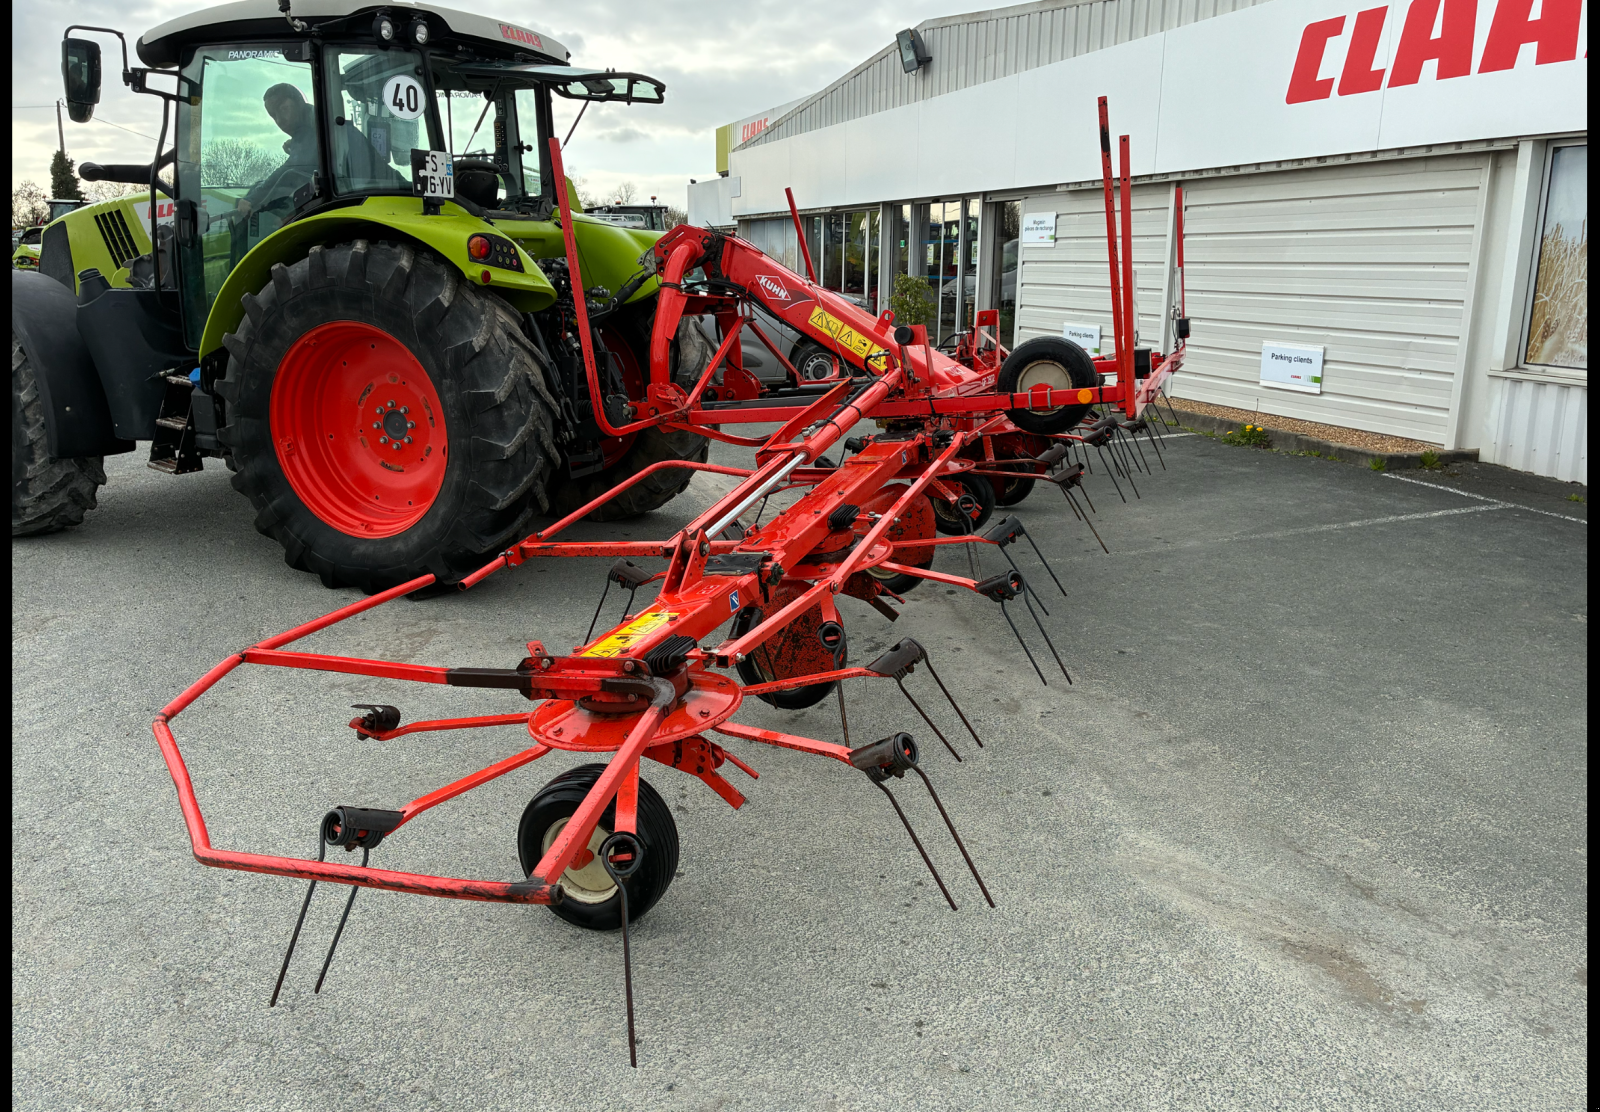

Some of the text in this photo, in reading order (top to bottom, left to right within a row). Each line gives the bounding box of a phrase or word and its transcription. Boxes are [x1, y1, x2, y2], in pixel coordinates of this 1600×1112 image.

[501, 24, 542, 48] CLAAS
[228, 50, 280, 59] PANORAMIC
[1286, 0, 1587, 105] CLAA
[392, 83, 419, 112] 40
[759, 276, 787, 299] KUHN
[1271, 353, 1313, 364] Parking clients
